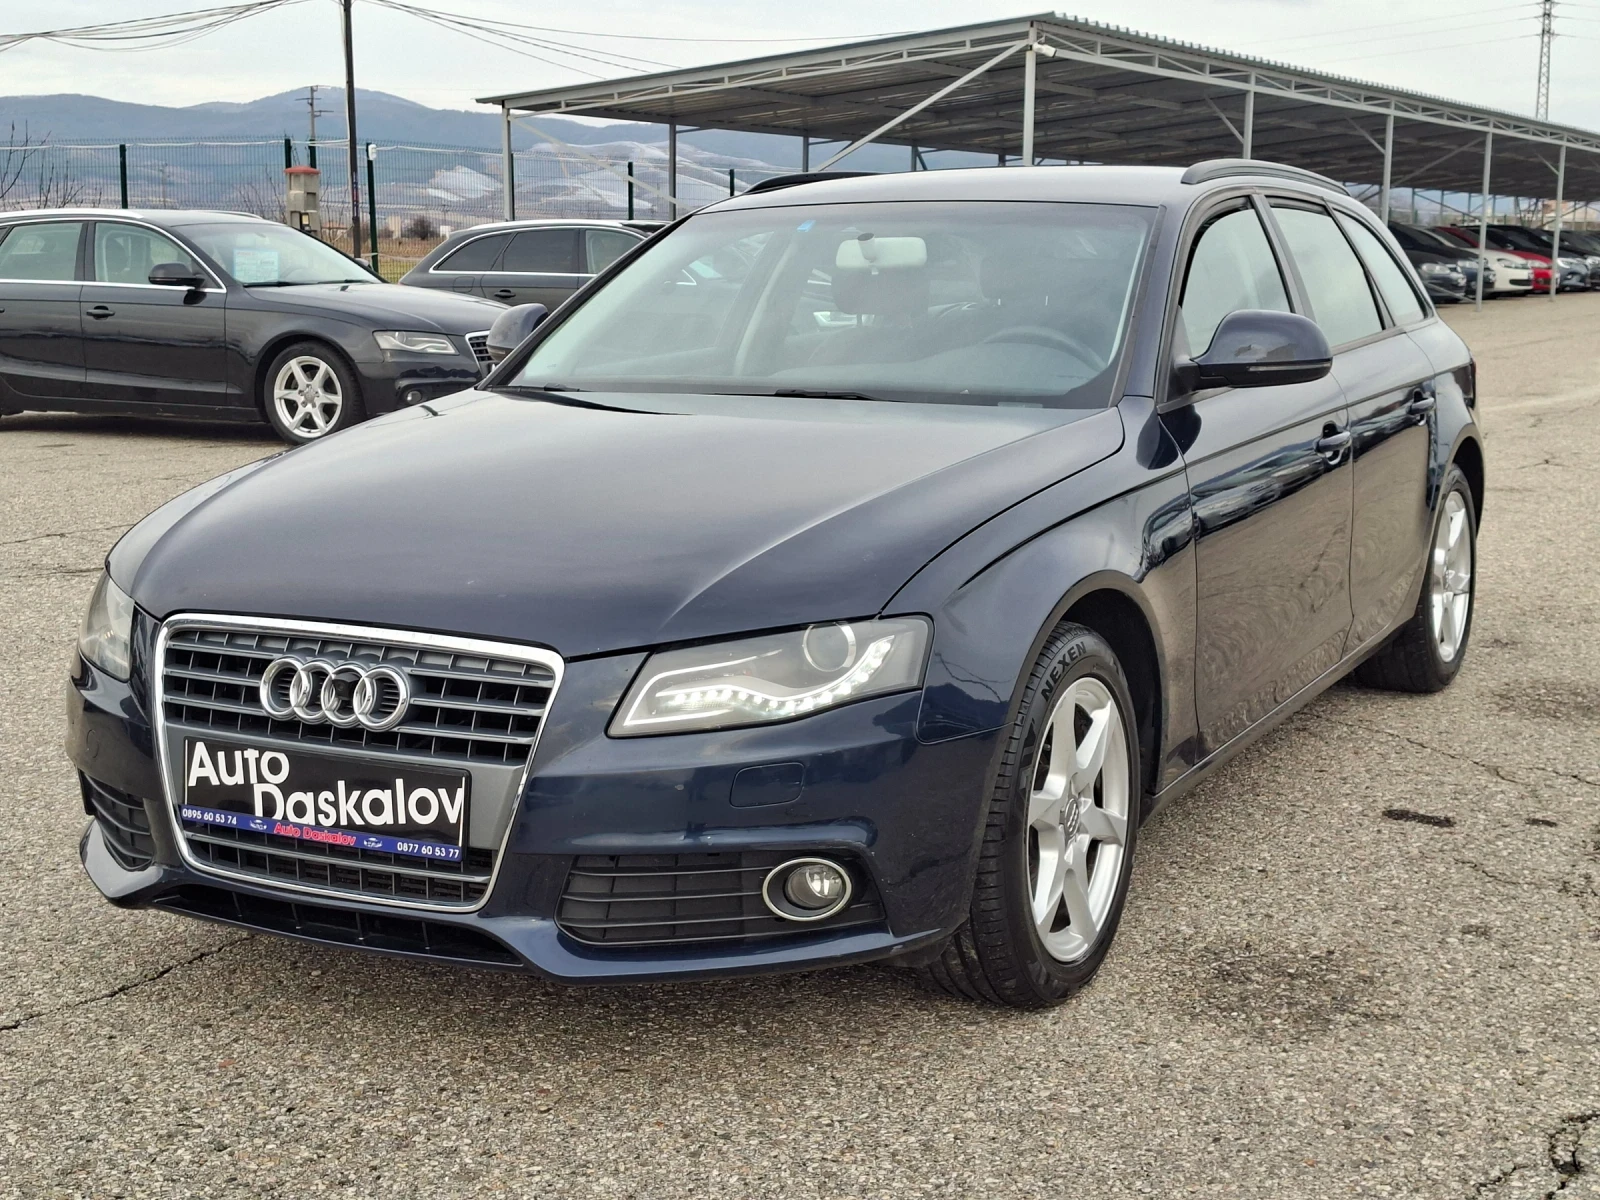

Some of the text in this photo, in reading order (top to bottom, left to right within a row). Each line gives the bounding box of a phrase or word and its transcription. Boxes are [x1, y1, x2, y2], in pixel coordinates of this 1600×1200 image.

[1041, 641, 1087, 702] NEXEN
[188, 741, 290, 787] Auto
[182, 808, 237, 825] 0895 60 53 74
[253, 778, 463, 827] Daskalov
[274, 822, 356, 846] Auto Daskalov
[397, 841, 460, 859] 0877 60 53 77
